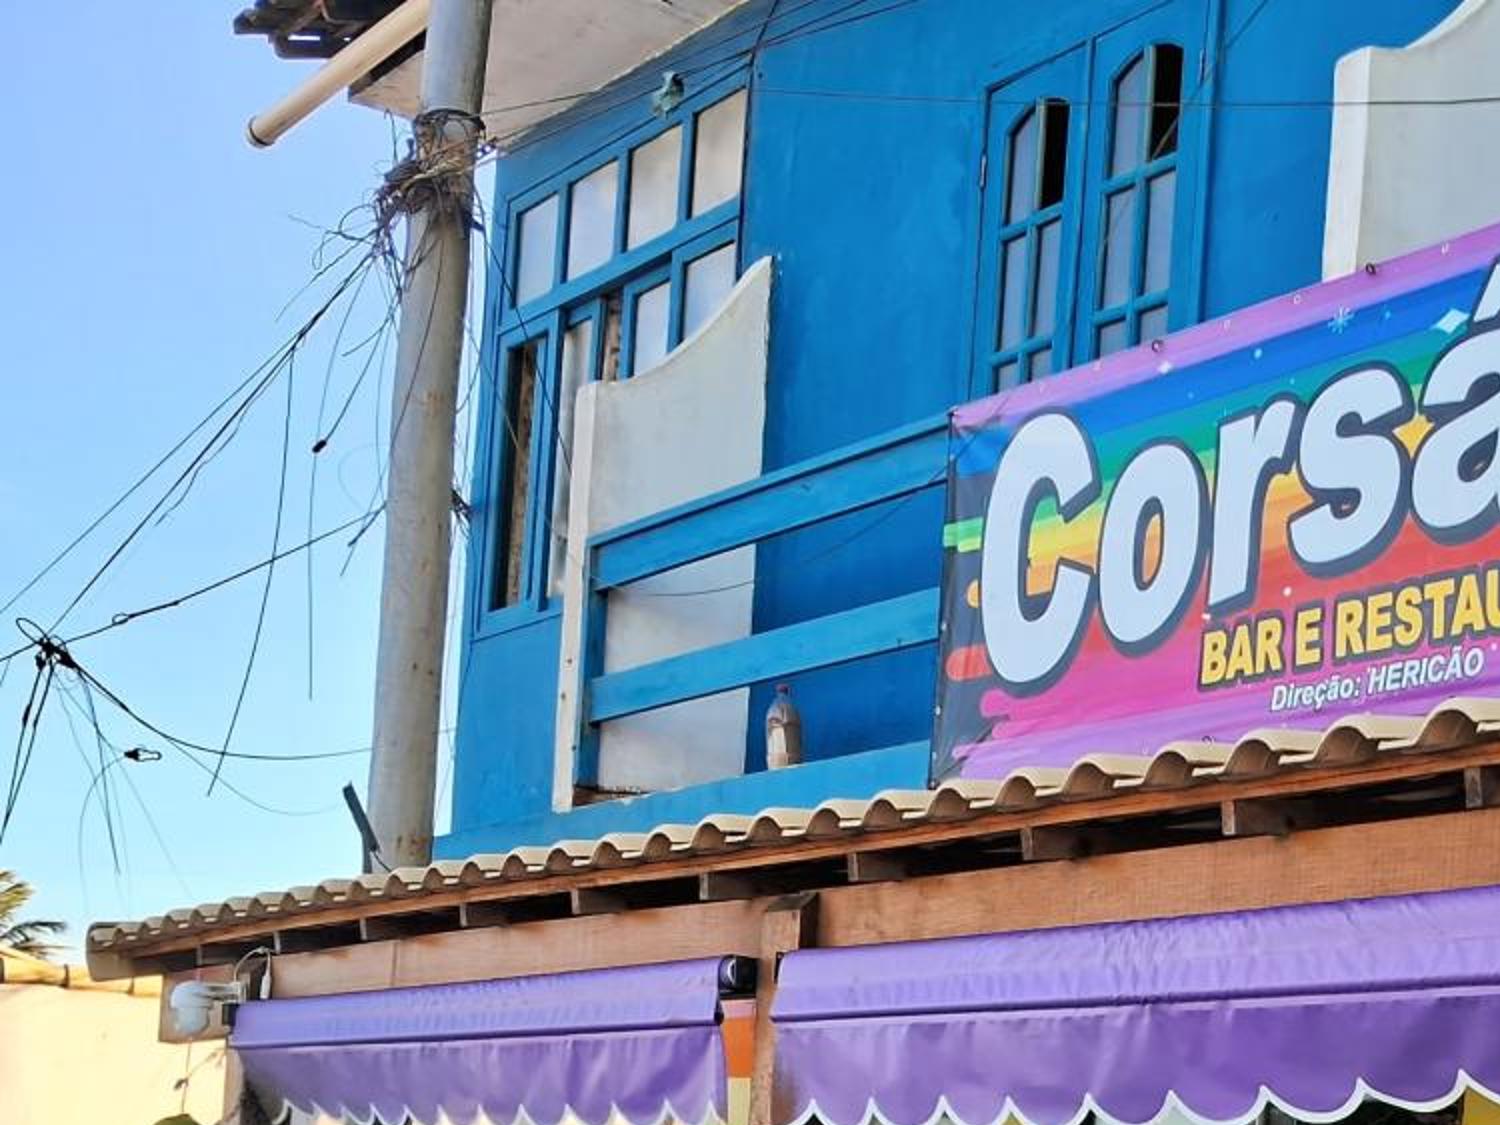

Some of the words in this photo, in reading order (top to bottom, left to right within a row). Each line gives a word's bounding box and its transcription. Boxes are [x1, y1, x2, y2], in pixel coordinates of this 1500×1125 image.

[1200, 612, 1283, 685] BAR
[1295, 608, 1323, 666] E
[1270, 675, 1362, 712] Direção:
